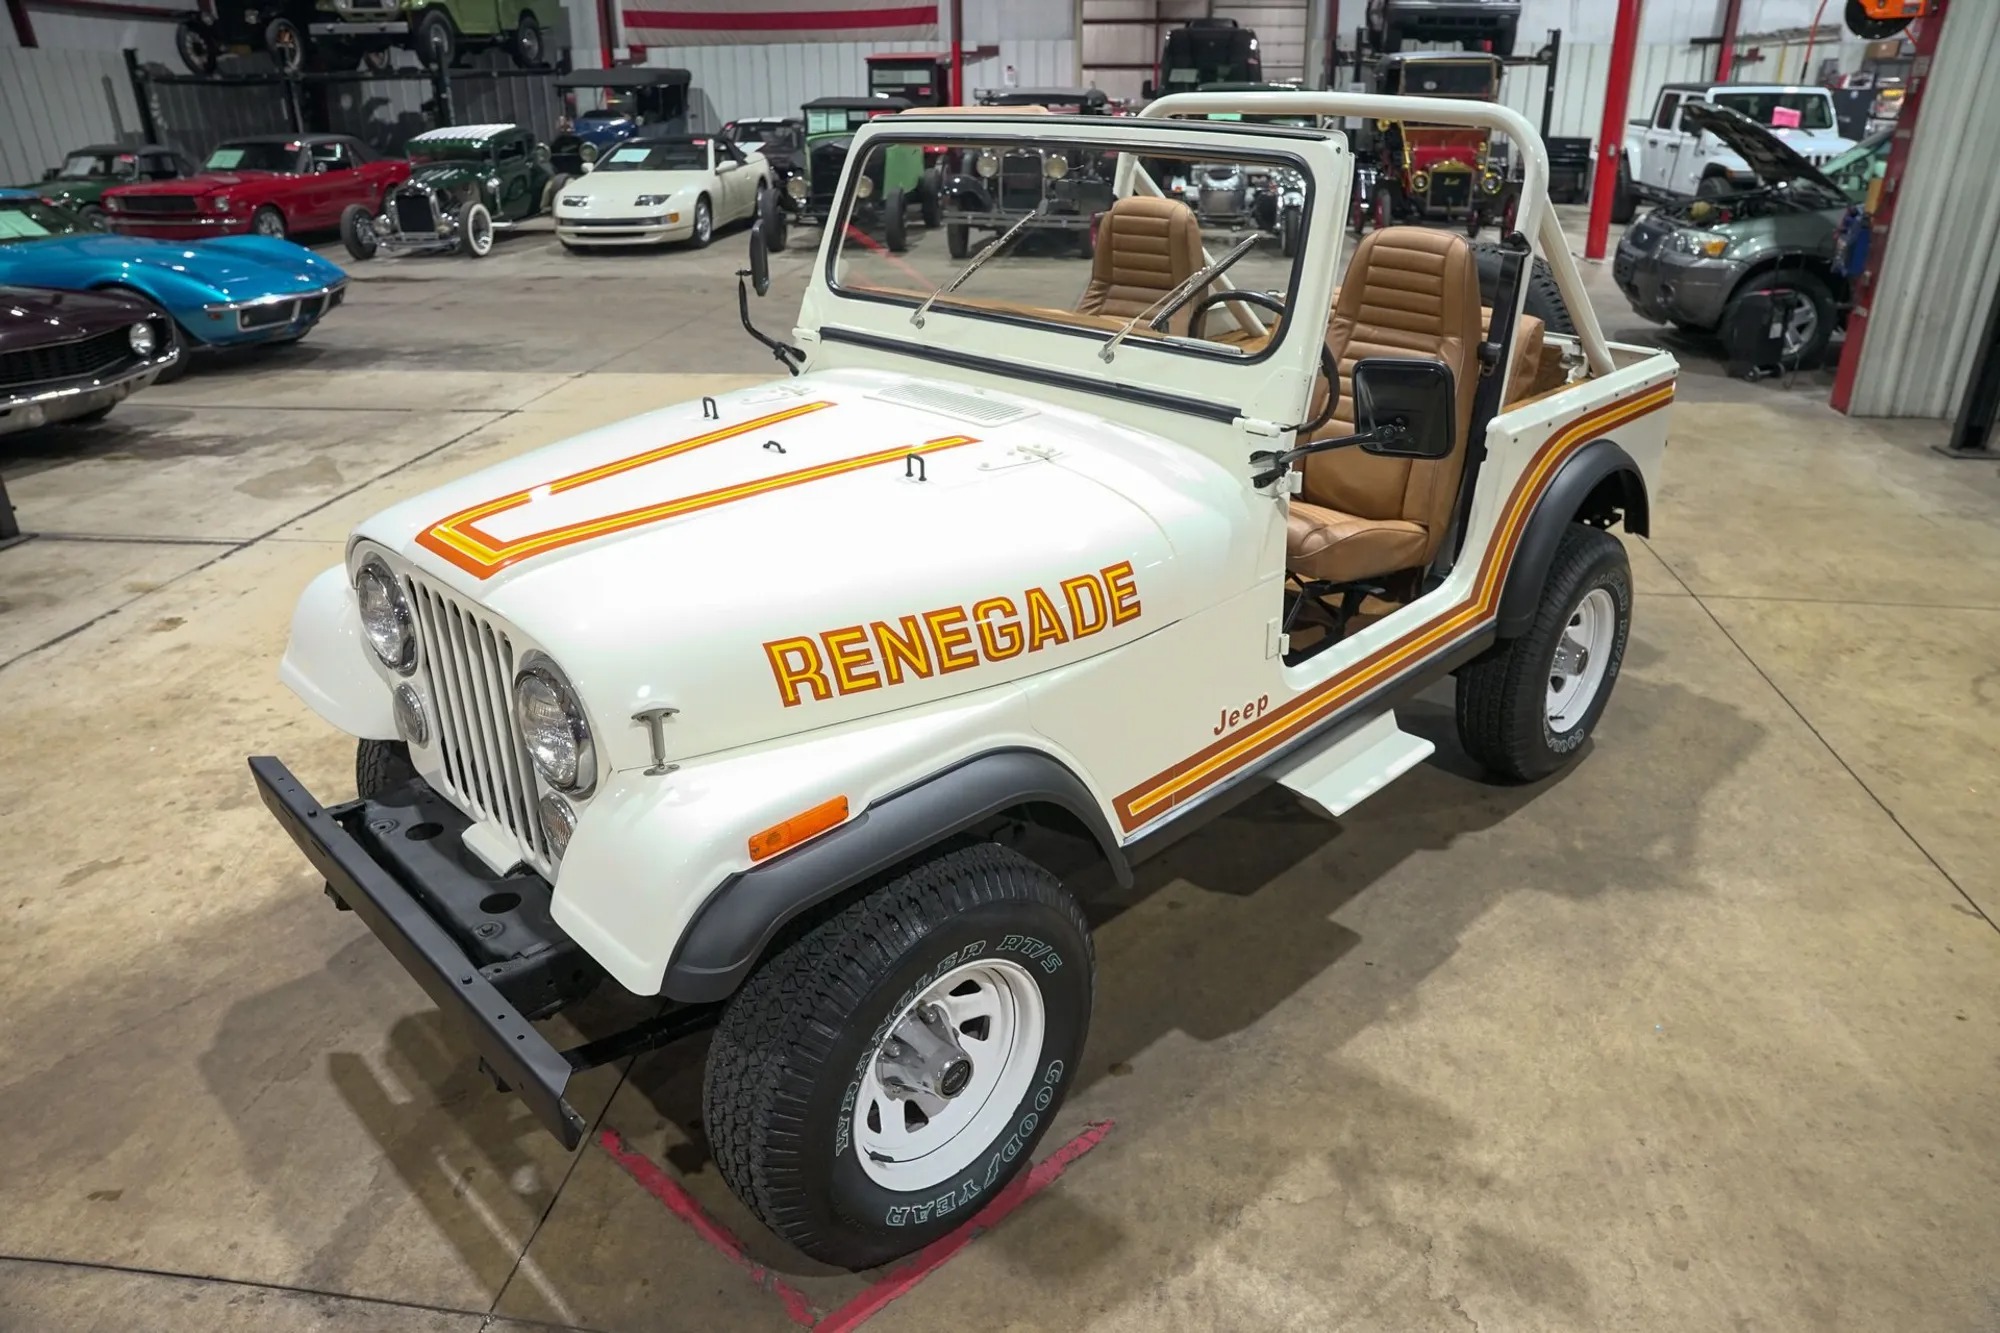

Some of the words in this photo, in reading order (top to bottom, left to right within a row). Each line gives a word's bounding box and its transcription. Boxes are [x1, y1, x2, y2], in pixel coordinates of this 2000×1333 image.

[762, 560, 1142, 708] RENEGADE
[1213, 694, 1269, 736] Jeep
[995, 935, 1063, 974] RT/S
[886, 1059, 1064, 1226] GOODYEAR
